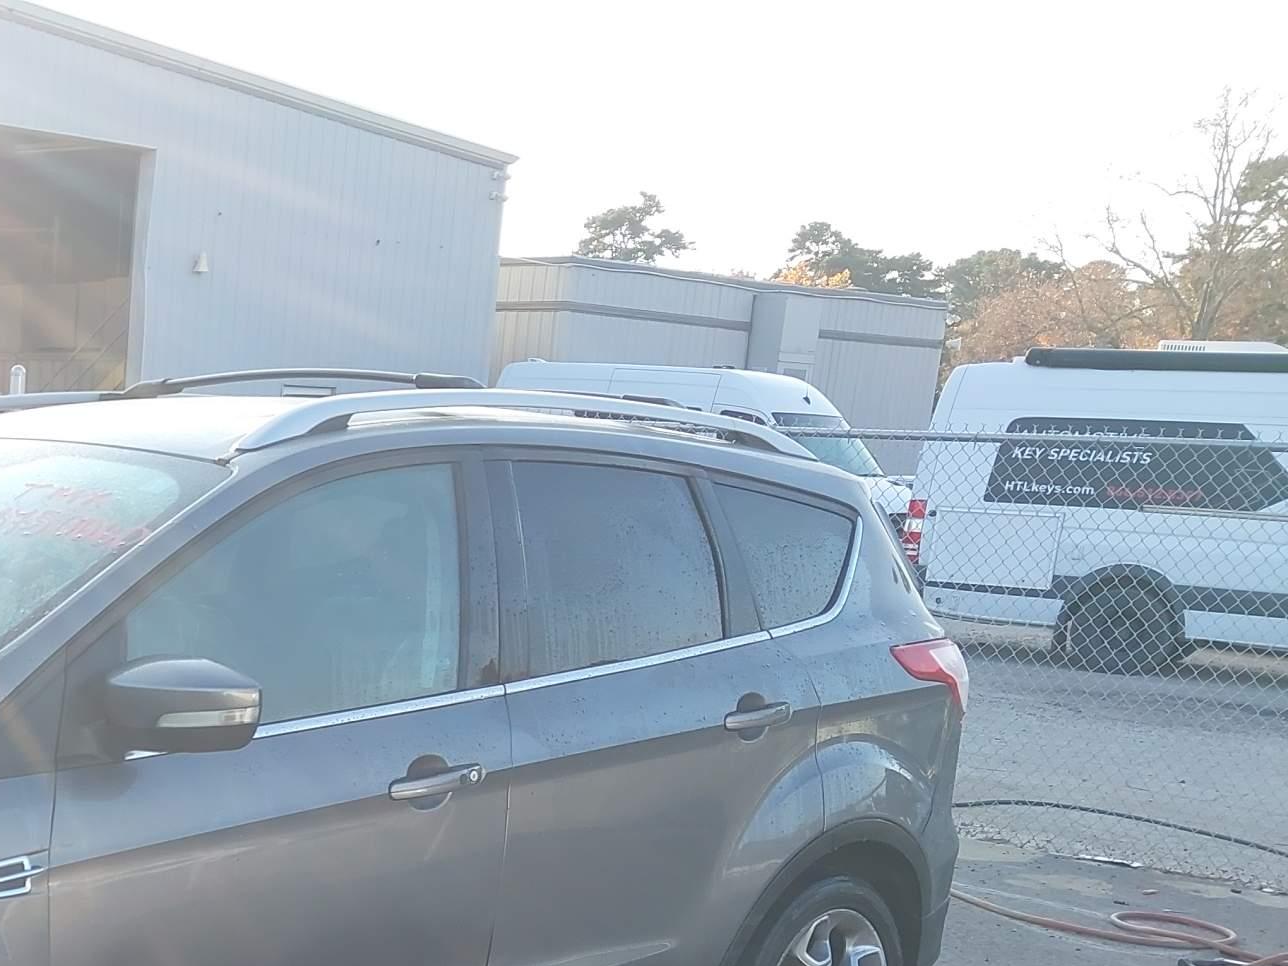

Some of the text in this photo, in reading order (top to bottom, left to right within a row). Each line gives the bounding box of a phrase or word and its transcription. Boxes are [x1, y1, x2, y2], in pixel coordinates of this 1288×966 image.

[1012, 446, 1153, 465] KEY SPECIALISTS
[1004, 480, 1095, 495] HTLkeys.com
